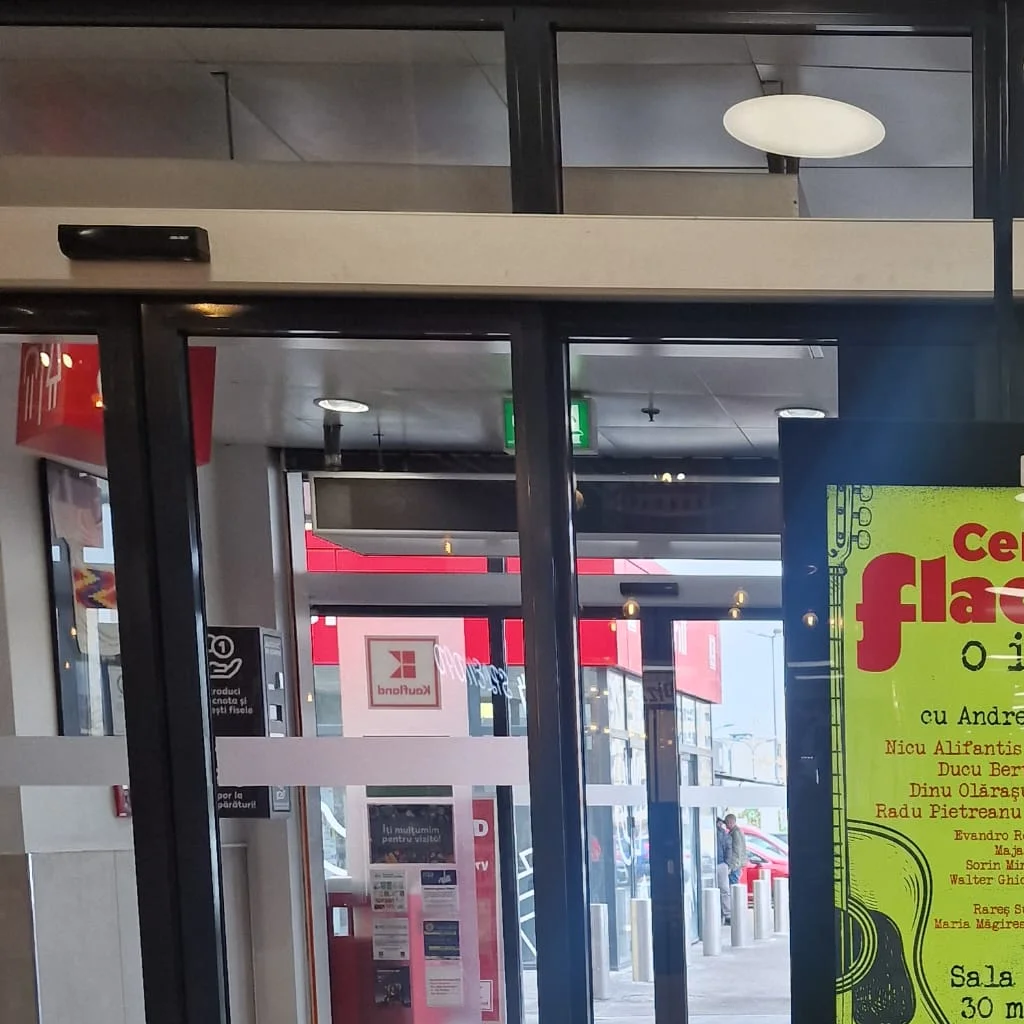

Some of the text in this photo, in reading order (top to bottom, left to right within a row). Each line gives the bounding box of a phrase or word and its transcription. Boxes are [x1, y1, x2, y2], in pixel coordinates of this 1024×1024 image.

[962, 640, 986, 671] o
[921, 710, 947, 725] cu
[885, 740, 926, 755] Nicu
[933, 740, 1022, 756] Alifantis
[938, 762, 982, 777] Ducu
[909, 783, 952, 798] Dinu
[875, 803, 922, 819] Radu
[929, 804, 1021, 819] Pietreanu
[953, 830, 1008, 841] Evandro
[966, 860, 1001, 871] Sorin
[950, 874, 993, 885] Walter
[973, 904, 1010, 917] Rareș
[934, 919, 971, 929] Maria
[951, 965, 1015, 987] Sala
[961, 996, 993, 1019] 30
